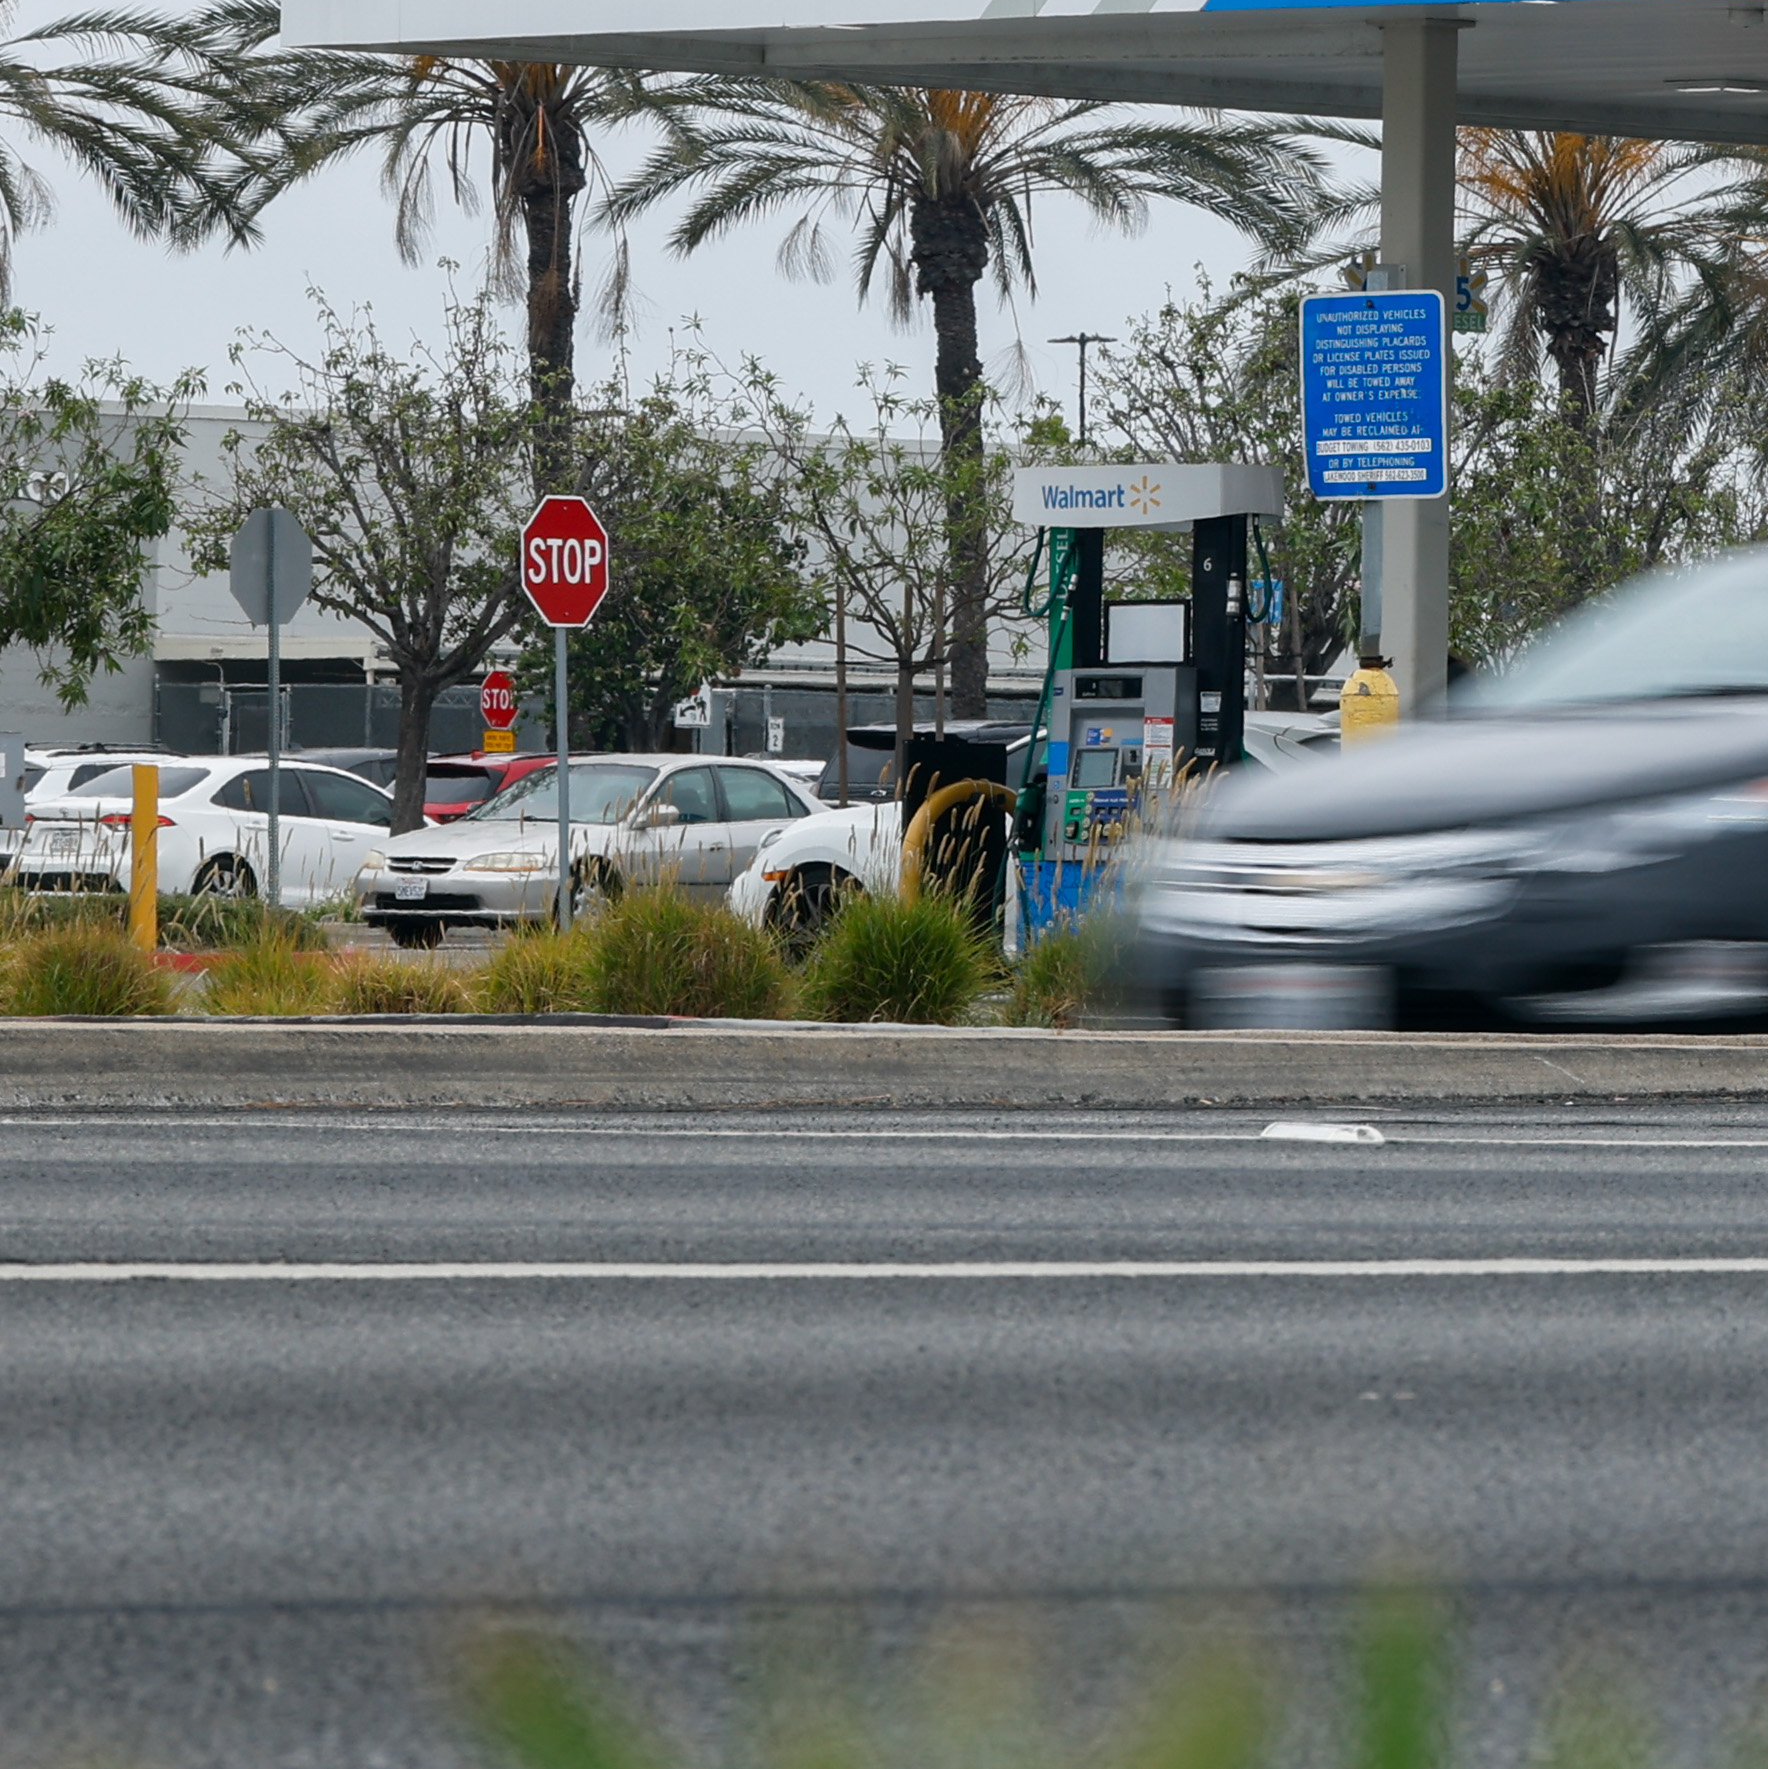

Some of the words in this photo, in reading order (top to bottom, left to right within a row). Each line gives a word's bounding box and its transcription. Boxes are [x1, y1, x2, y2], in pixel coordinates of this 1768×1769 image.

[1456, 276, 1471, 311] 5
[1316, 311, 1379, 323] UNAUTHORIZED
[1383, 309, 1426, 320] VEHICLES
[1337, 325, 1352, 335] NOT
[1356, 323, 1404, 334] DISPLAYING
[1316, 337, 1378, 349] DISTINGUISHING
[1382, 336, 1427, 347] PLACARDS
[1313, 353, 1324, 363] OR
[1327, 352, 1360, 362] LICENSE
[1364, 350, 1394, 360] PLATES
[1399, 349, 1430, 360] ISSUED
[1320, 366, 1336, 376] FOR
[1340, 364, 1378, 375] DISABLED
[1382, 362, 1422, 373] PERSONS
[1326, 379, 1344, 388] WILL
[1348, 377, 1358, 388] BE
[1363, 377, 1390, 387] TOWED
[1394, 376, 1415, 386] AWAY
[1322, 392, 1331, 402] AT
[1335, 391, 1374, 401] OWNER'S
[1334, 413, 1361, 424] TOWED
[1366, 411, 1408, 422] VEHICLES
[1322, 427, 1338, 437] MAY
[1341, 426, 1352, 437] BE
[1357, 425, 1408, 436] RECLAIMED
[1316, 442, 1340, 454] BUDGET
[1342, 442, 1369, 453] TOWING
[1373, 441, 1394, 452] (562)
[1396, 440, 1430, 451] 435-0103
[1328, 458, 1339, 469] OR
[1342, 458, 1354, 468] BY
[1357, 456, 1415, 468] TELEPHONING
[1325, 471, 1356, 481] LAKEWOOD
[1357, 471, 1383, 481] SHERIFF
[1042, 484, 1125, 509] Walmart
[529, 537, 601, 584] STOP
[1203, 557, 1212, 572] 6
